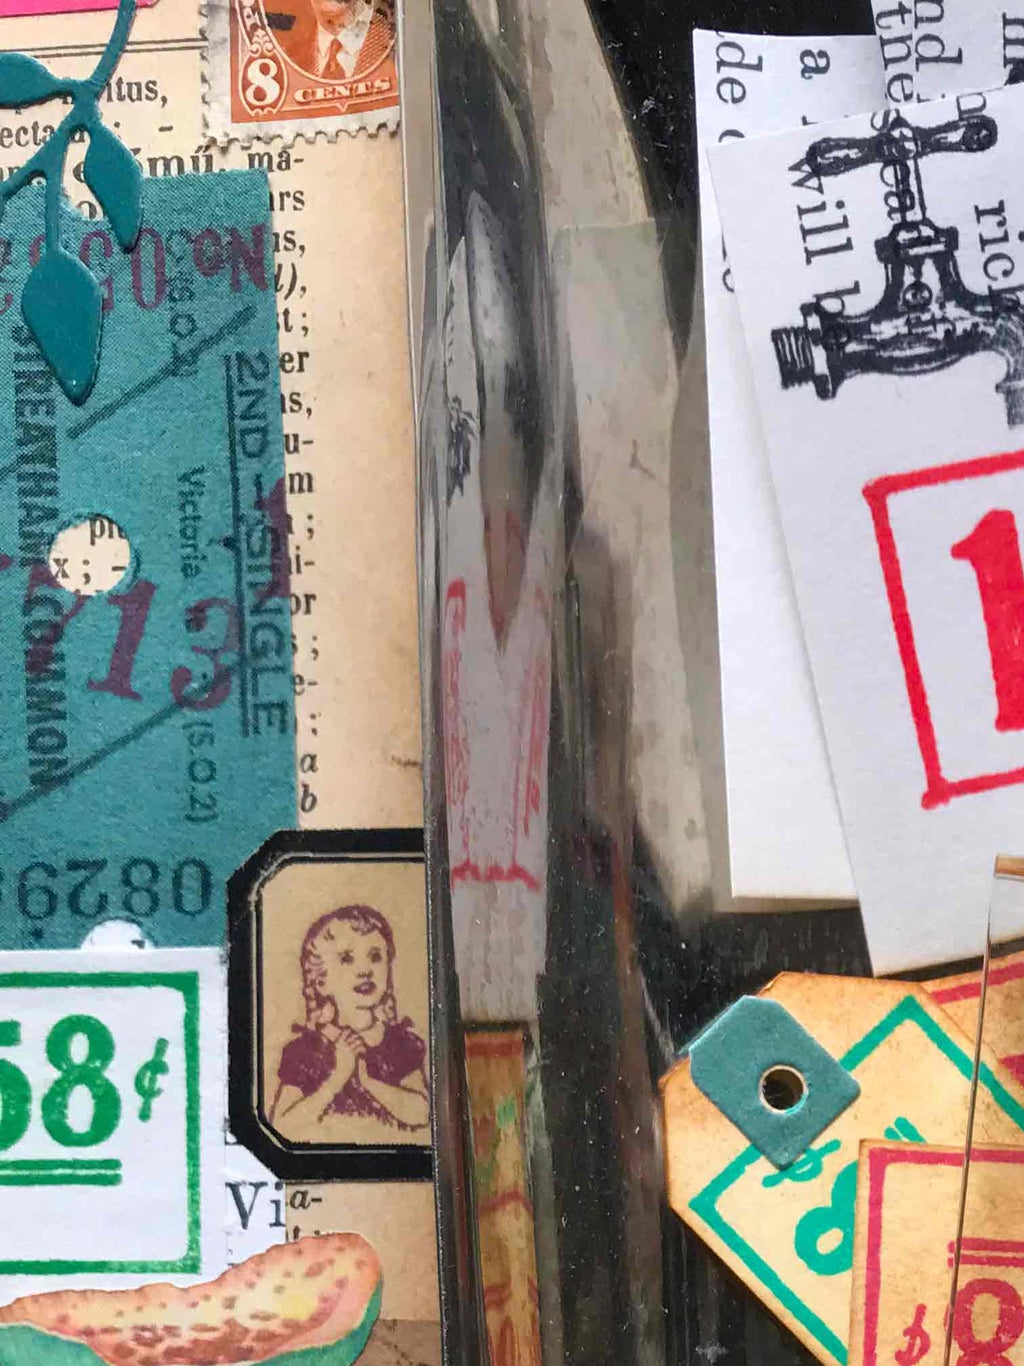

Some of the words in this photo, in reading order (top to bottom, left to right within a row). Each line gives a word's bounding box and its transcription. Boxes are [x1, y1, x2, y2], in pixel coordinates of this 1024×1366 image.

[245, 58, 280, 106] 8
[293, 76, 391, 103] CENTS
[714, 31, 763, 104] de
[787, 157, 855, 266] will
[234, 350, 271, 461] 2ND
[177, 465, 210, 580] Victoria
[245, 522, 289, 737] SINGLE
[20, 595, 69, 787] COMMON
